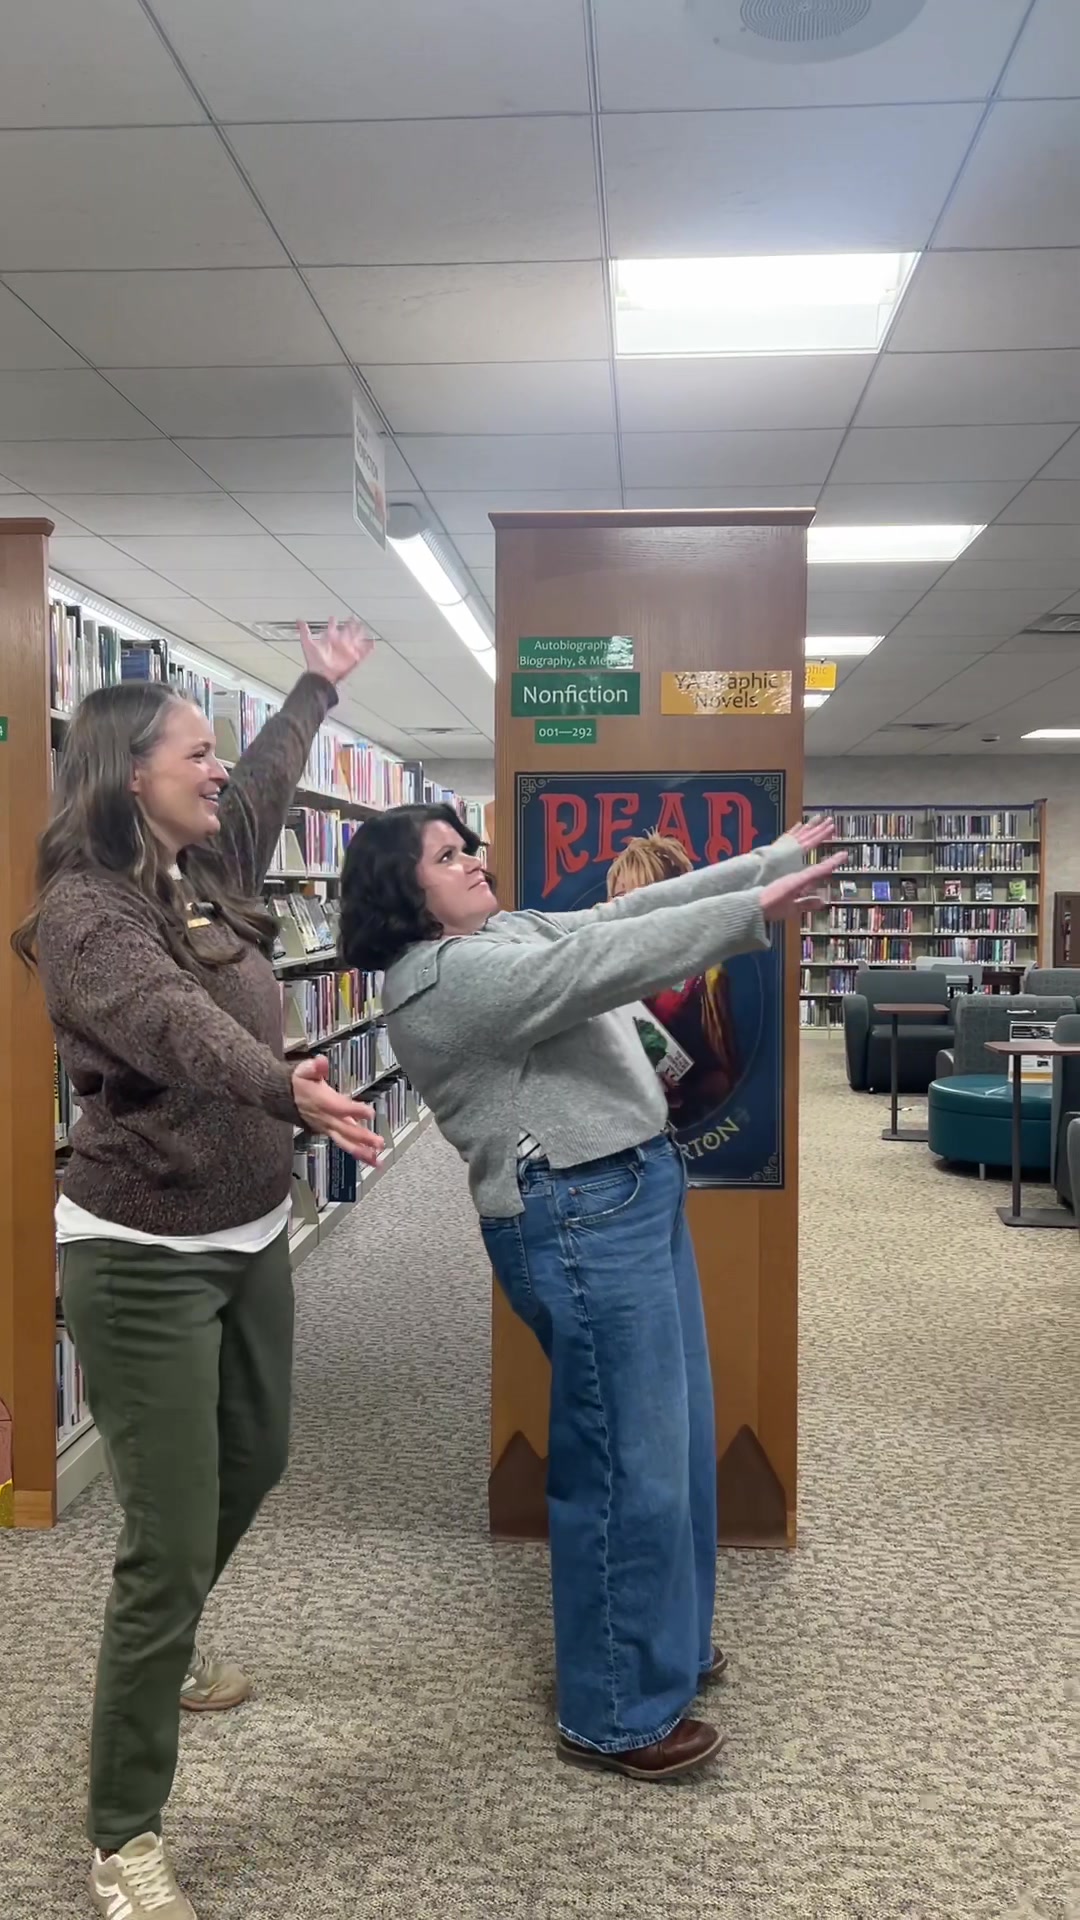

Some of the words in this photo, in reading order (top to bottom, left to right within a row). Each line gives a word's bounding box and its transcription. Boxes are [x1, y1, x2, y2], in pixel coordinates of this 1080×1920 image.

[534, 640, 614, 653] Autobiograph
[520, 656, 576, 669] Biography,
[578, 656, 587, 666] &
[523, 684, 628, 704] Nonfiction
[695, 691, 758, 708] Novels
[539, 792, 759, 898] READ
